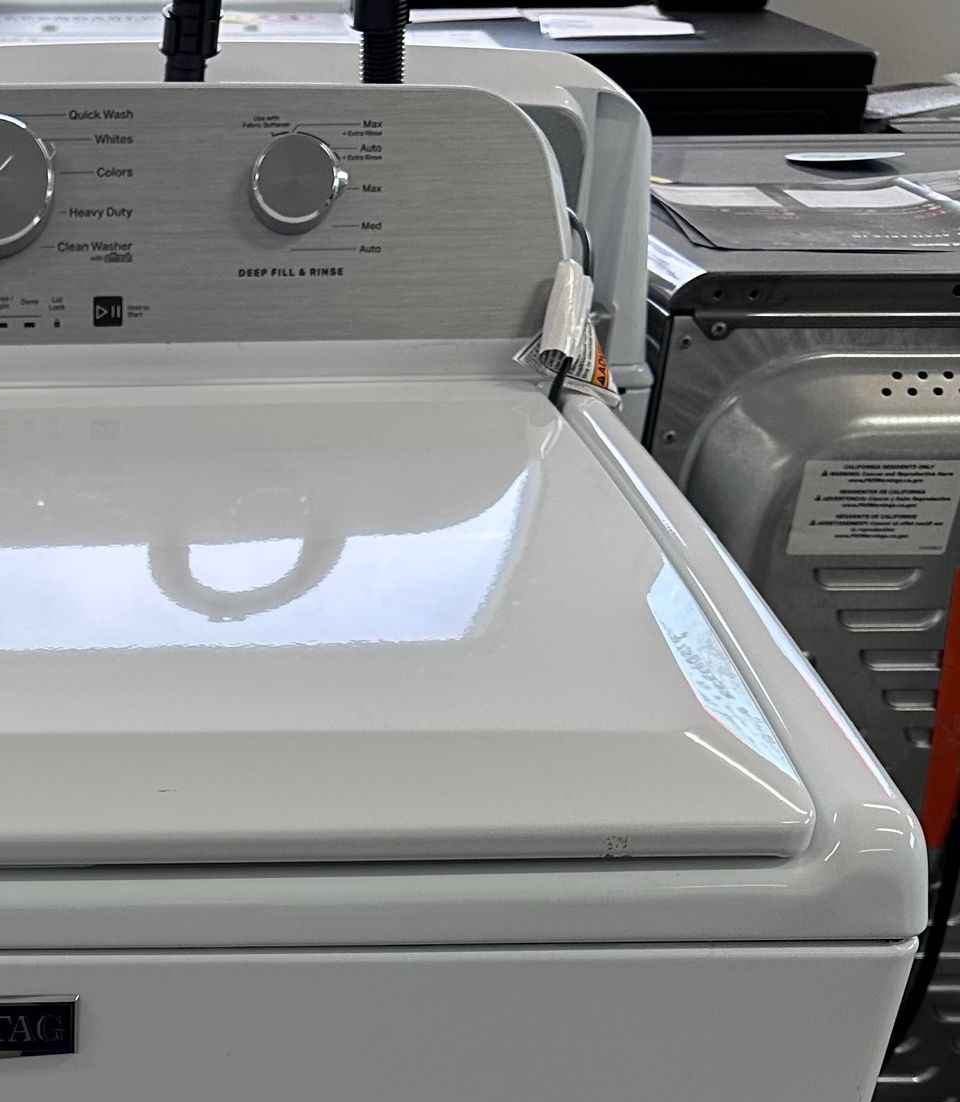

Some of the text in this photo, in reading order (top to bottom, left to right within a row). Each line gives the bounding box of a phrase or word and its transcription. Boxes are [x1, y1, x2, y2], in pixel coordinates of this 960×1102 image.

[68, 109, 134, 121] Quick Wash
[362, 120, 383, 128] Max
[95, 134, 133, 145] Whites
[360, 144, 382, 153] Auto
[96, 167, 133, 178] Colors
[362, 184, 382, 193] Max
[69, 207, 133, 219] Heavy Duty
[361, 221, 382, 231] Med
[57, 240, 133, 252] Clean Washer
[359, 244, 382, 254] Auto
[238, 267, 344, 278] DEEP FILL & RINSE
[20, 298, 39, 306] Done
[51, 296, 63, 304] Lid
[48, 303, 65, 311] Lock
